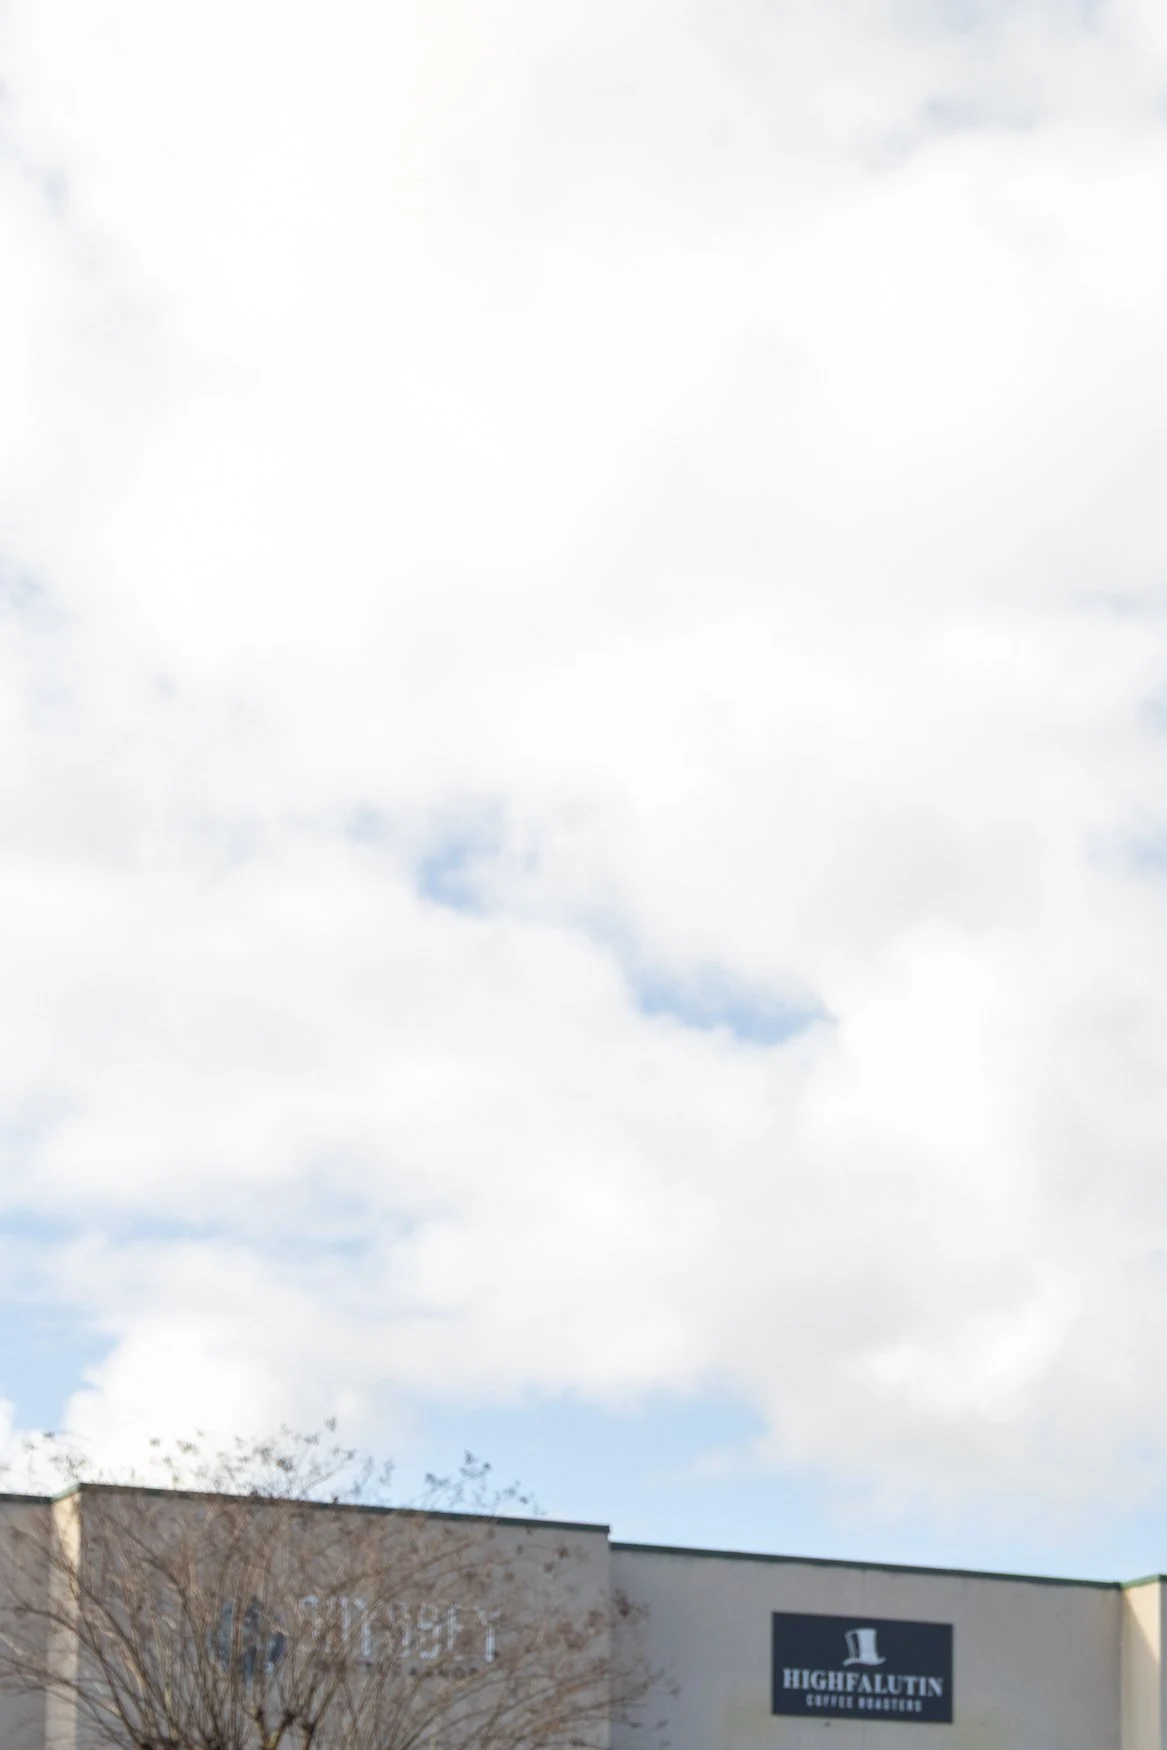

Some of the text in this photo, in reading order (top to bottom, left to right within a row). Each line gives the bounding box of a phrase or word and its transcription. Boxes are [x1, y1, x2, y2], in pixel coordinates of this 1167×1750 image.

[783, 1668, 944, 1697] HIGHFALUTIN
[806, 1694, 922, 1712] COFFEE ROASTERS
